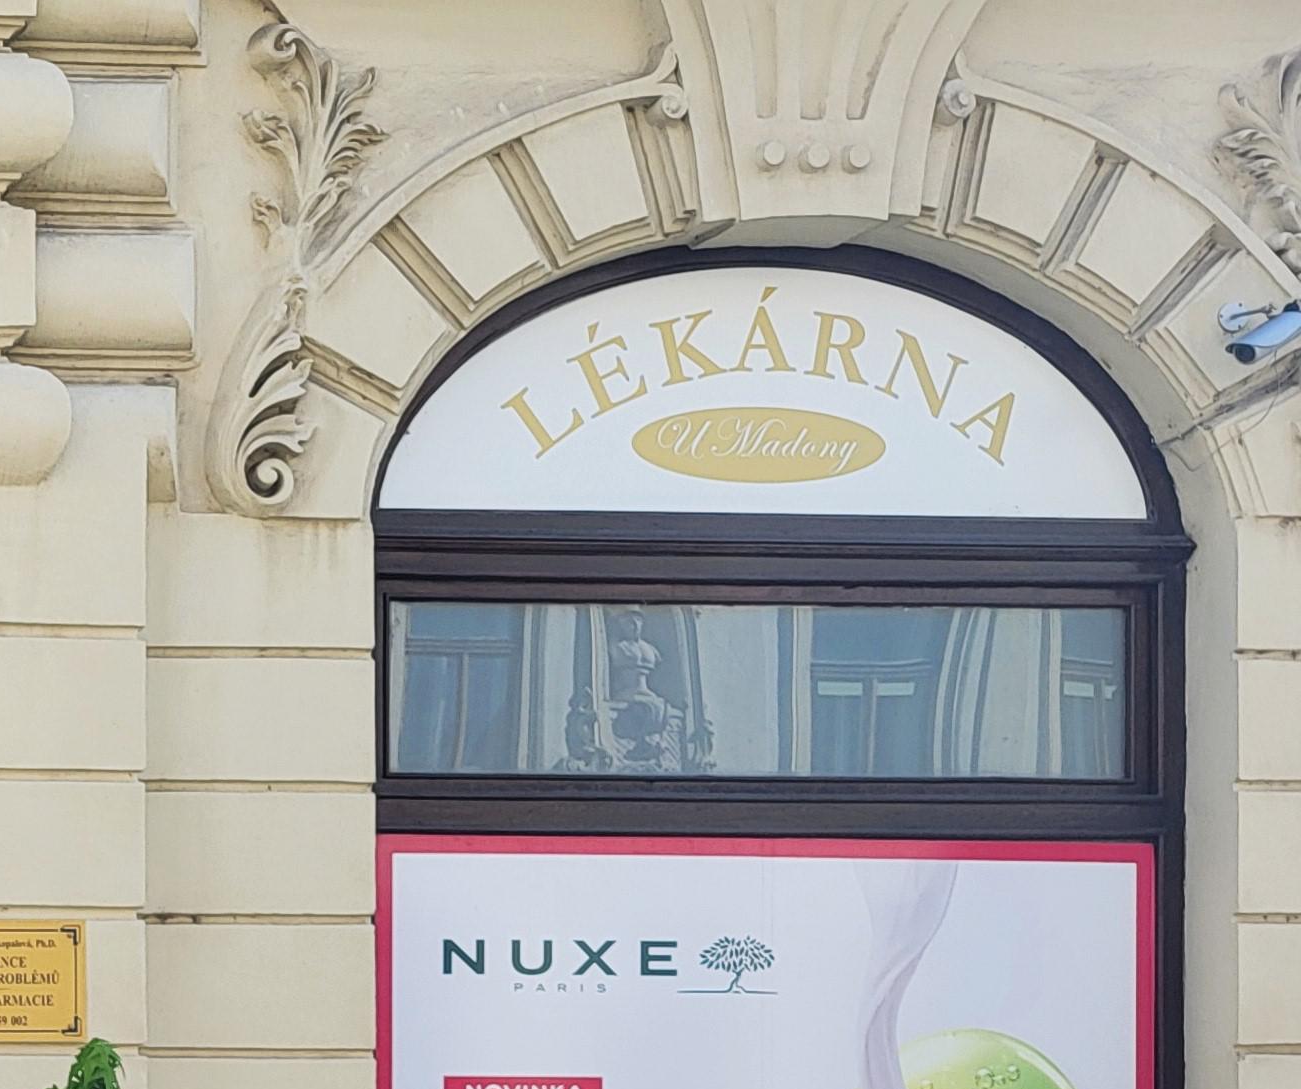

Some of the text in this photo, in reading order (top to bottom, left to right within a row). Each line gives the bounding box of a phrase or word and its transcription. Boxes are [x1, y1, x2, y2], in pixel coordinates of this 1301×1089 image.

[500, 286, 1017, 467] LÉKÁRNA
[657, 415, 859, 475] U Madony
[441, 938, 679, 977] NUXE
[513, 981, 607, 994] PARIS
[10, 1015, 28, 1027] 002
